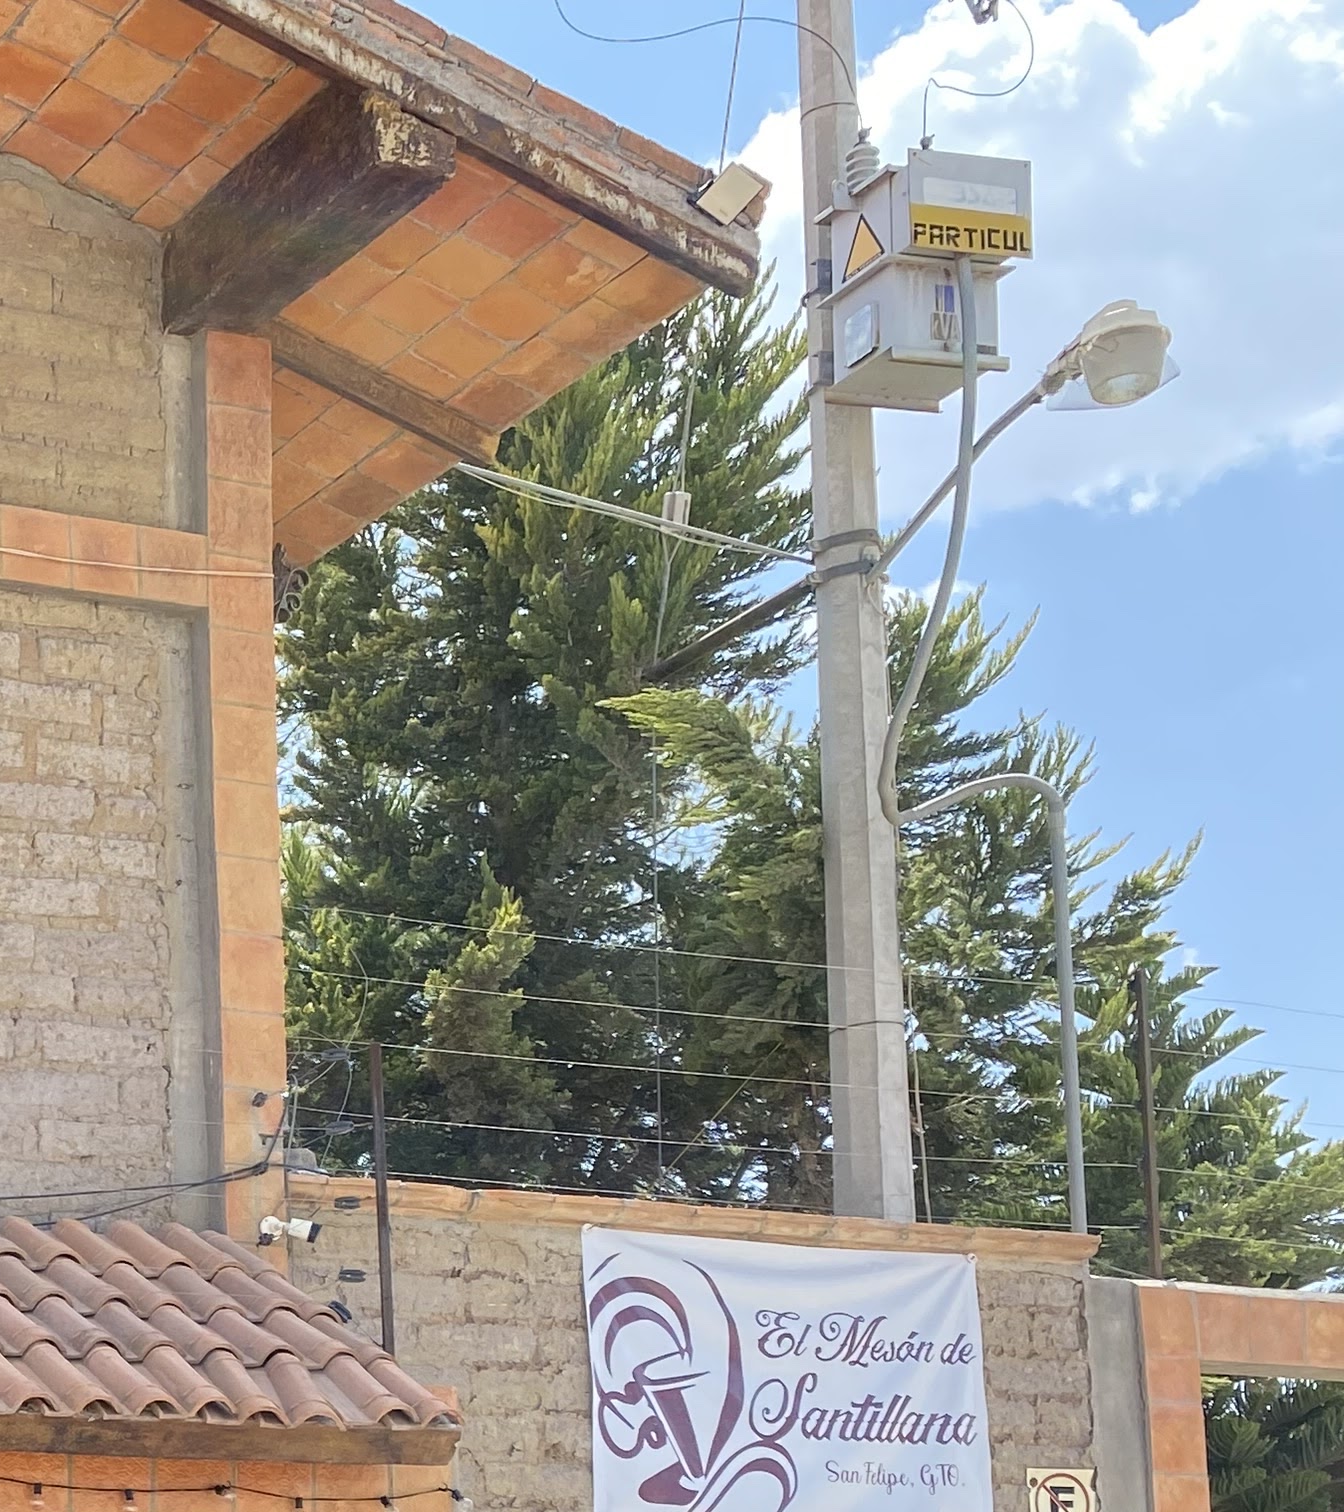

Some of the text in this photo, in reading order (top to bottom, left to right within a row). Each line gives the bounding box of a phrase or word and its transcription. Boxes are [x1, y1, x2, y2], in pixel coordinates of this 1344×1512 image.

[912, 222, 1031, 252] PARTICUL
[755, 1309, 977, 1368] El Mesón de
[748, 1372, 978, 1446] Santillana
[825, 1460, 861, 1483] San
